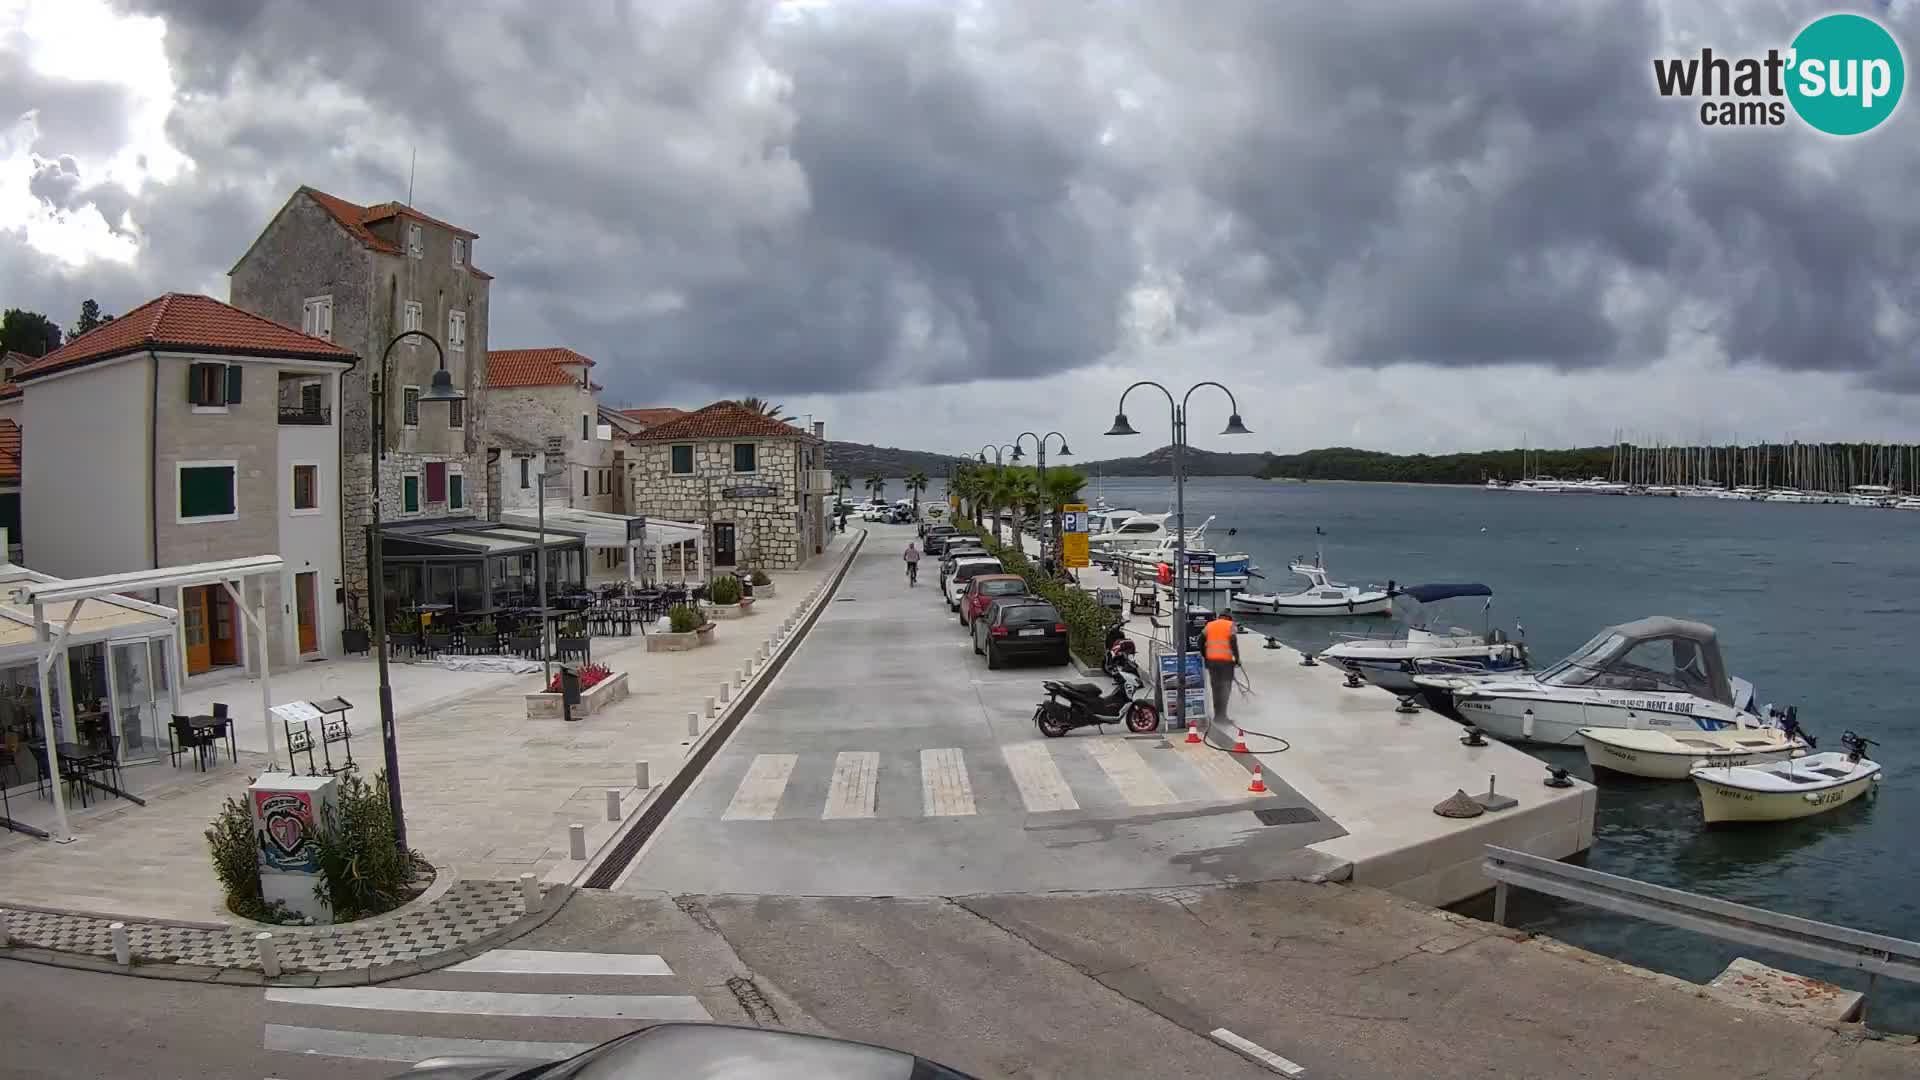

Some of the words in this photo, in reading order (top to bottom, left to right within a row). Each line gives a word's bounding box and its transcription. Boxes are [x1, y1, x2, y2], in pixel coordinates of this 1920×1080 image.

[1065, 514, 1076, 531] P
[1646, 700, 1666, 711] RENT
[1667, 702, 1674, 711] A
[1674, 702, 1694, 713] BOAT
